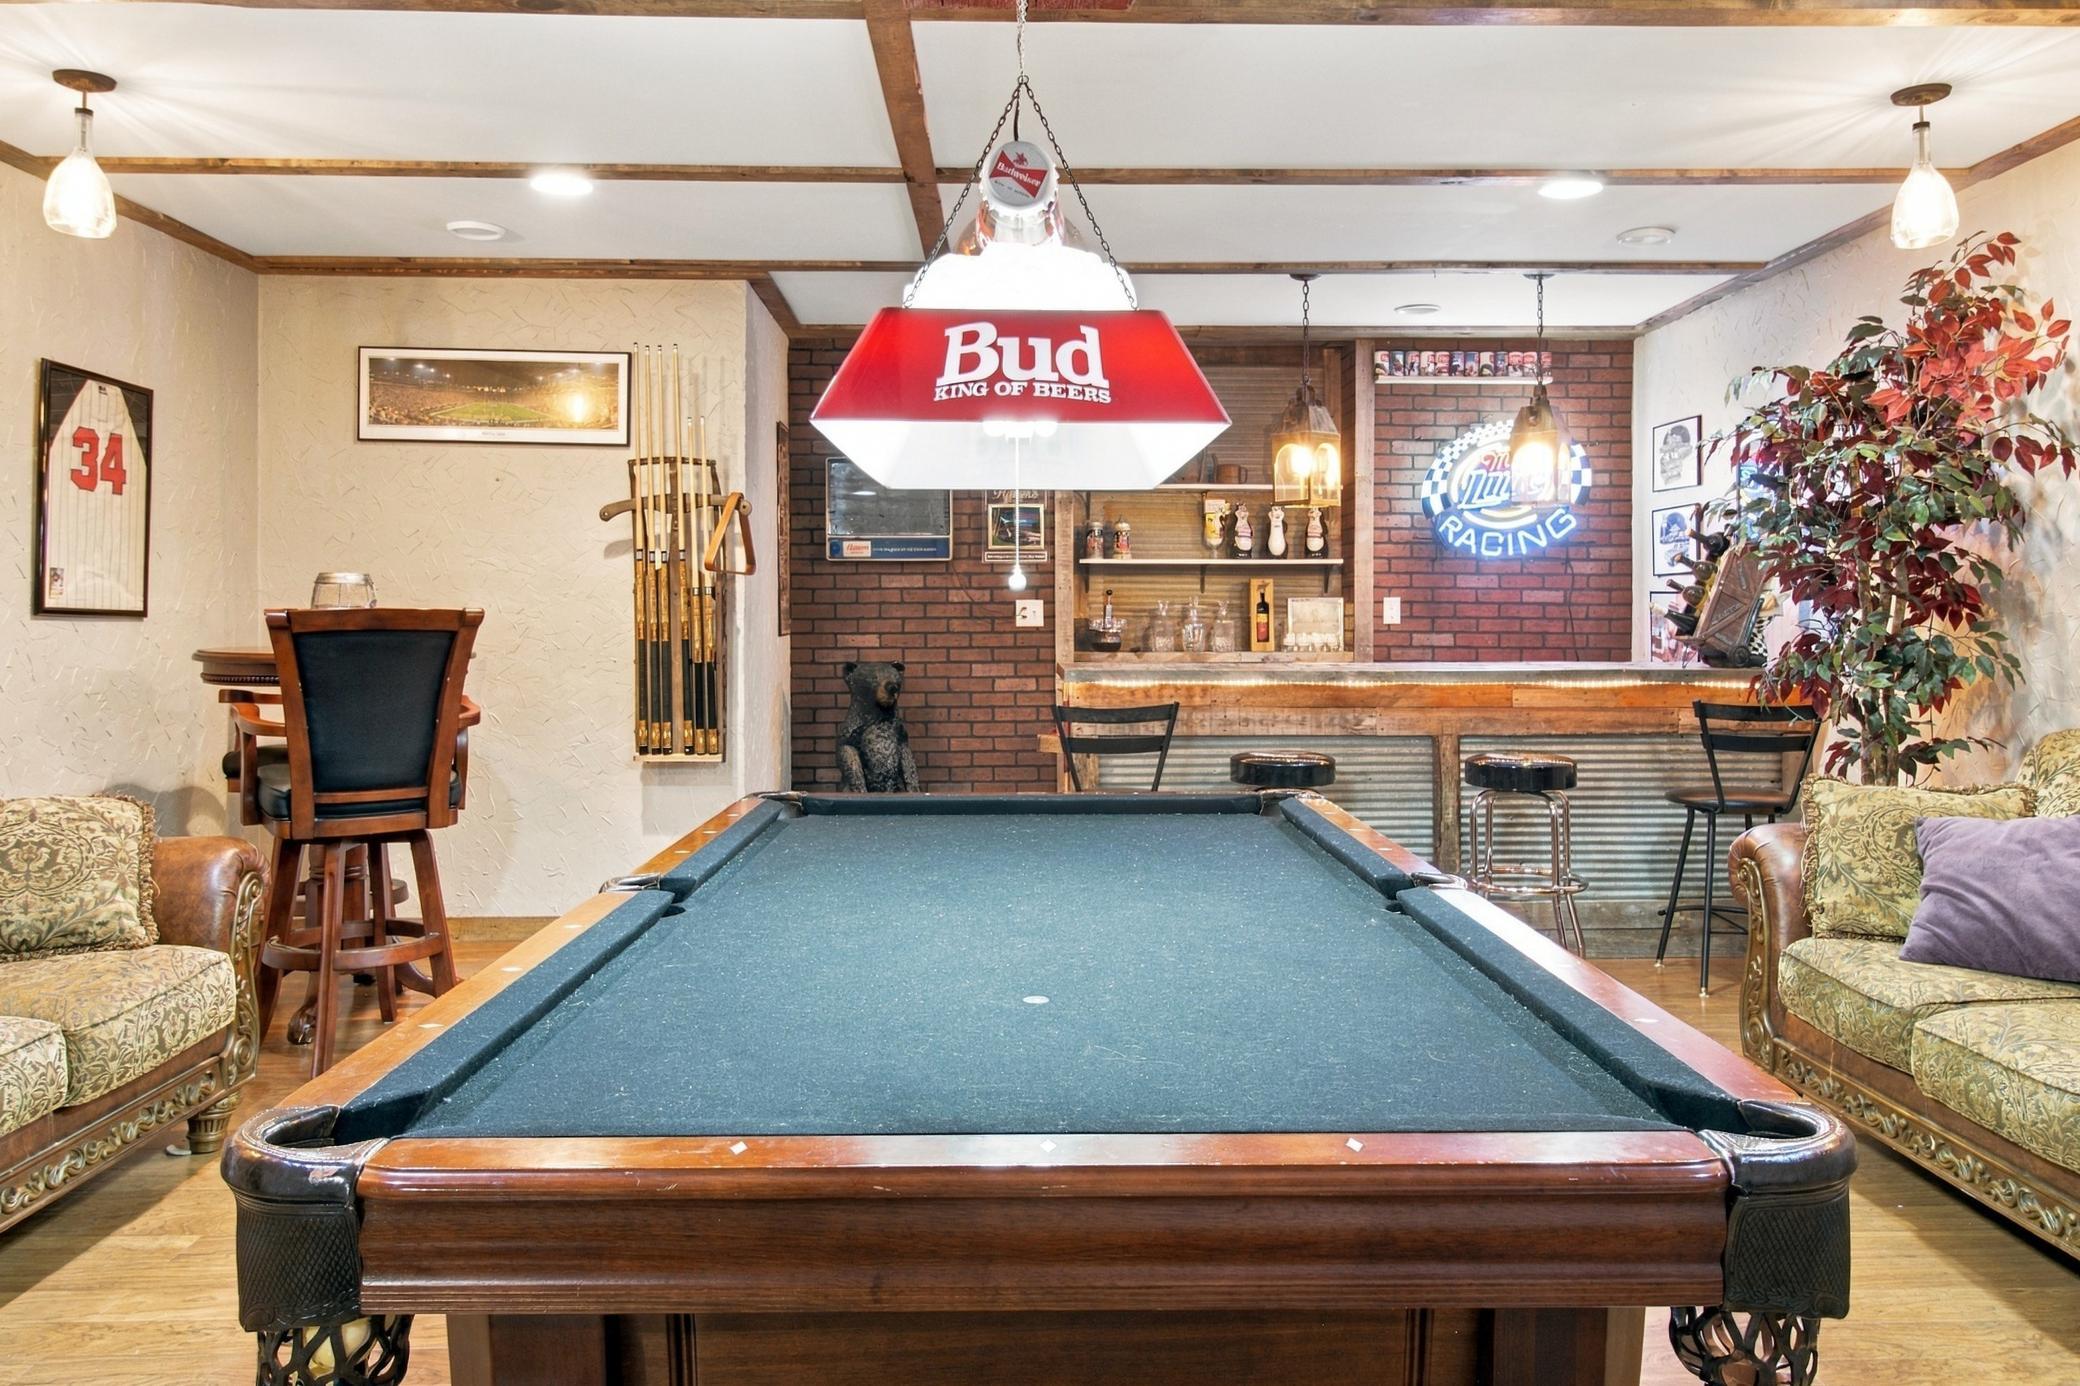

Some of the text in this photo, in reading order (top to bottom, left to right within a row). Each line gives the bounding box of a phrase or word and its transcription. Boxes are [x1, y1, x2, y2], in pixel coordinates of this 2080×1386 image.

[936, 321, 1110, 389] Bud
[934, 381, 1111, 404] KING OF BEERS
[70, 426, 126, 495] 34
[1439, 508, 1577, 556] RACING
